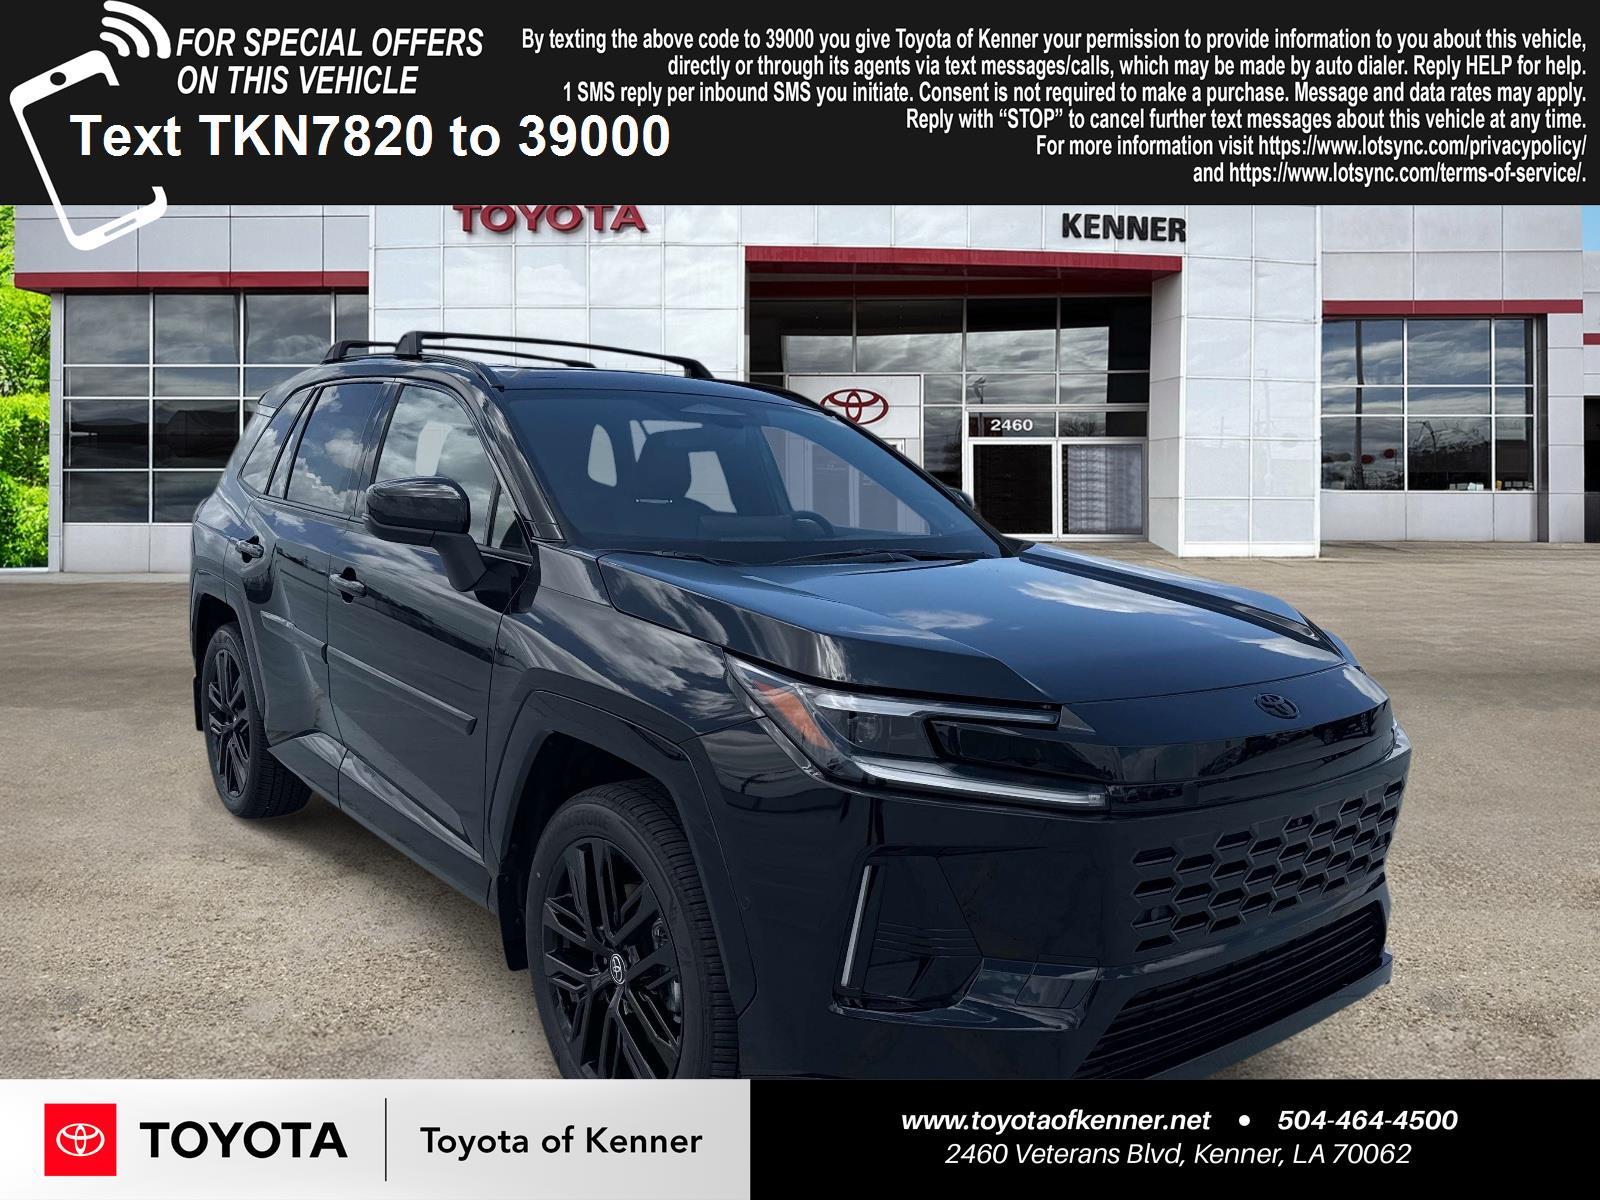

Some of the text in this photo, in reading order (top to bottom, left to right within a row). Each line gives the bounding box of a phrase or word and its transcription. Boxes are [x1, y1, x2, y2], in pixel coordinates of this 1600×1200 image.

[453, 205, 647, 233] TOYOTA
[1062, 213, 1187, 242] KENNER
[990, 419, 1034, 432] 2460
